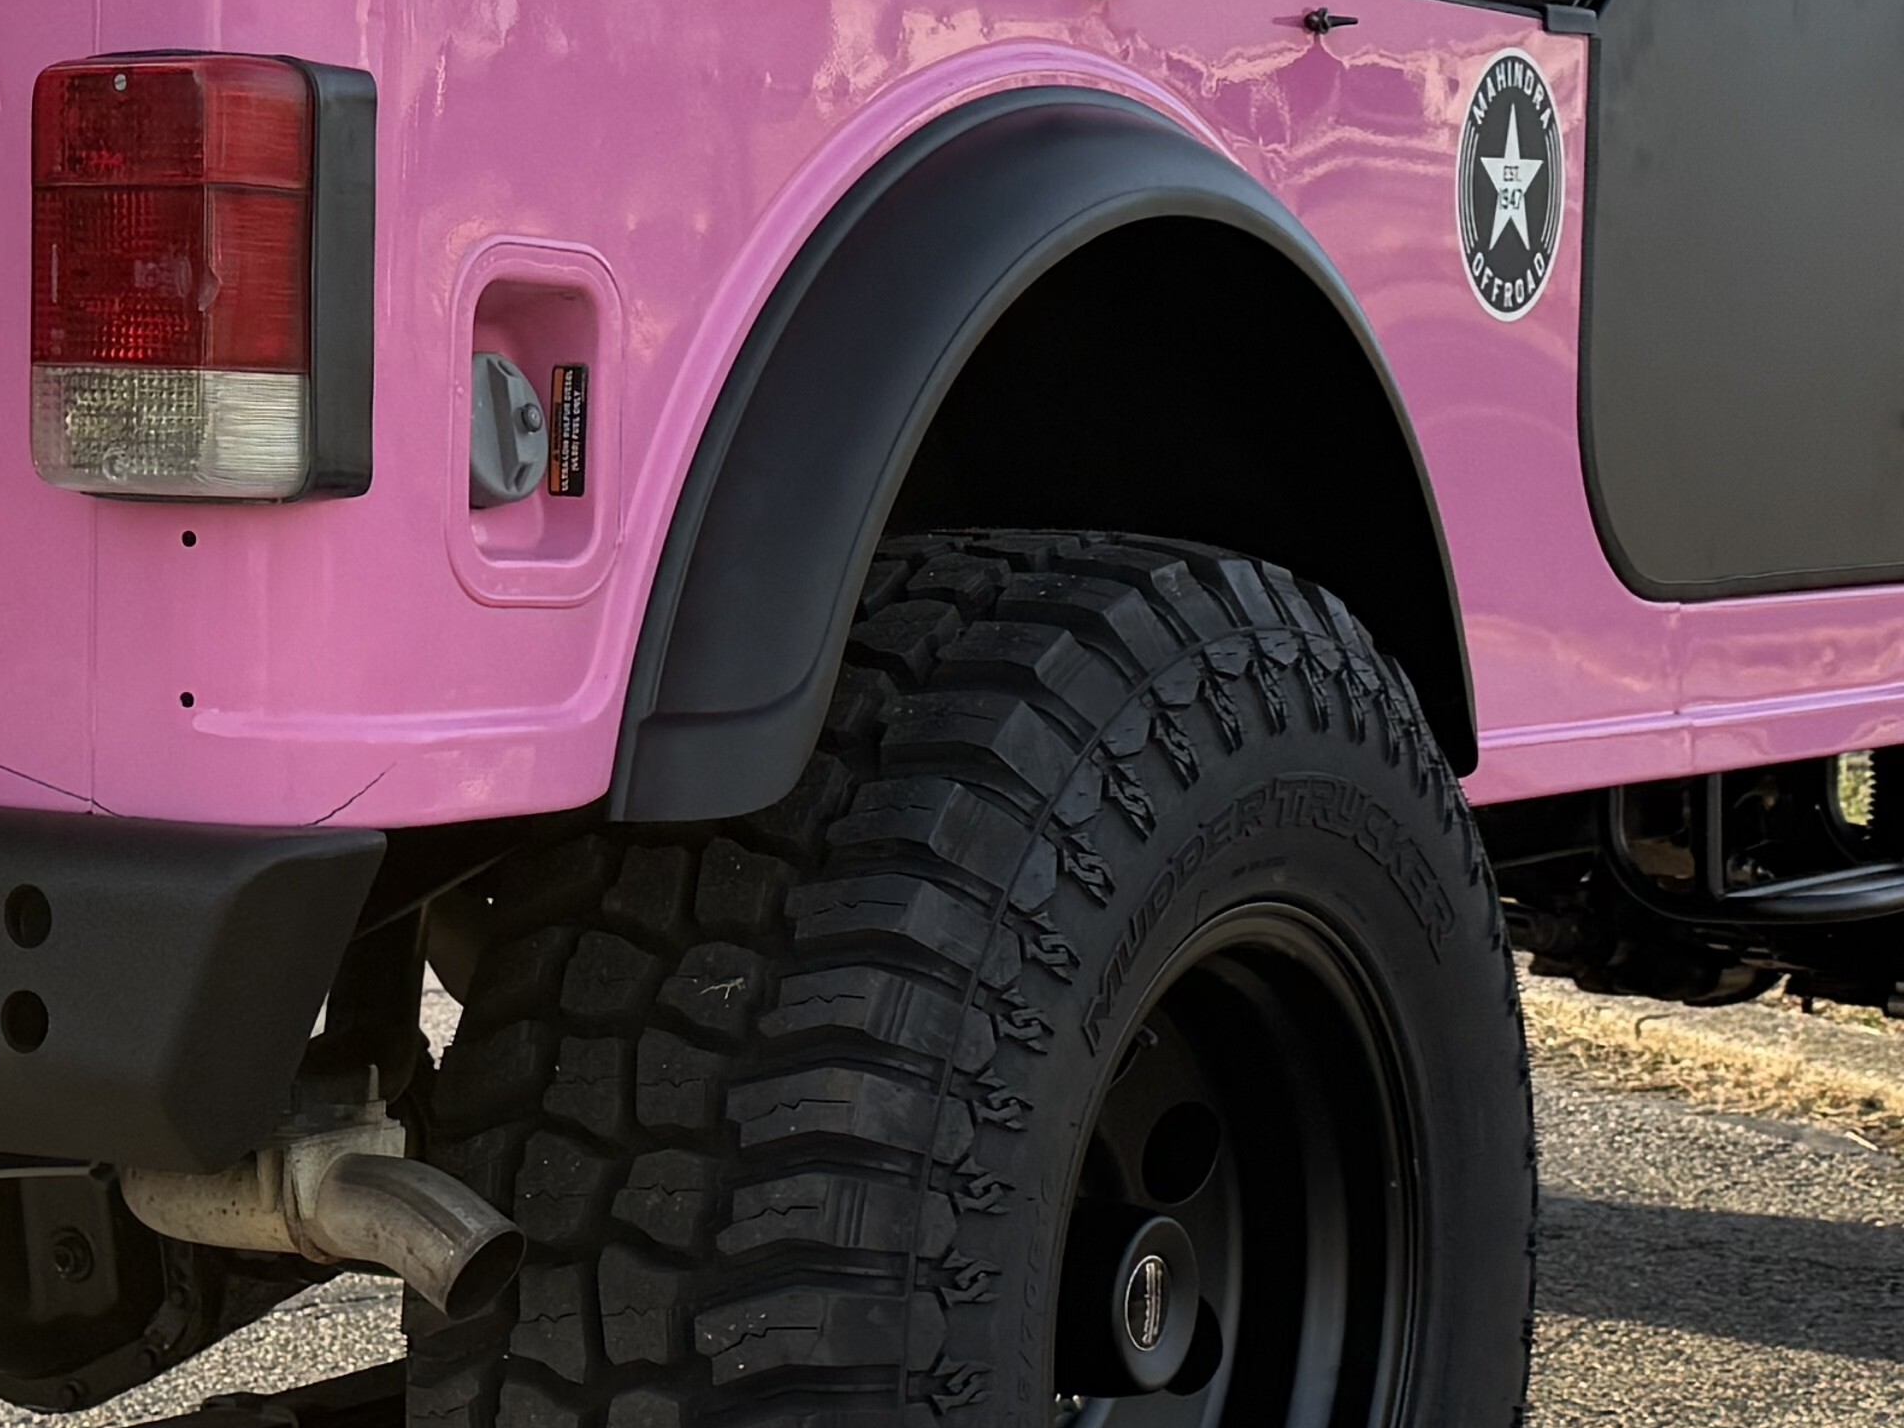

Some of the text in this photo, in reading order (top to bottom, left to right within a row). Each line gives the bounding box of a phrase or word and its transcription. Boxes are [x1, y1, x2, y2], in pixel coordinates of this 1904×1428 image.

[1472, 59, 1554, 130] MAHINDRA
[1471, 251, 1547, 308] OFFROAD
[1081, 779, 1270, 1057] MUDDER
